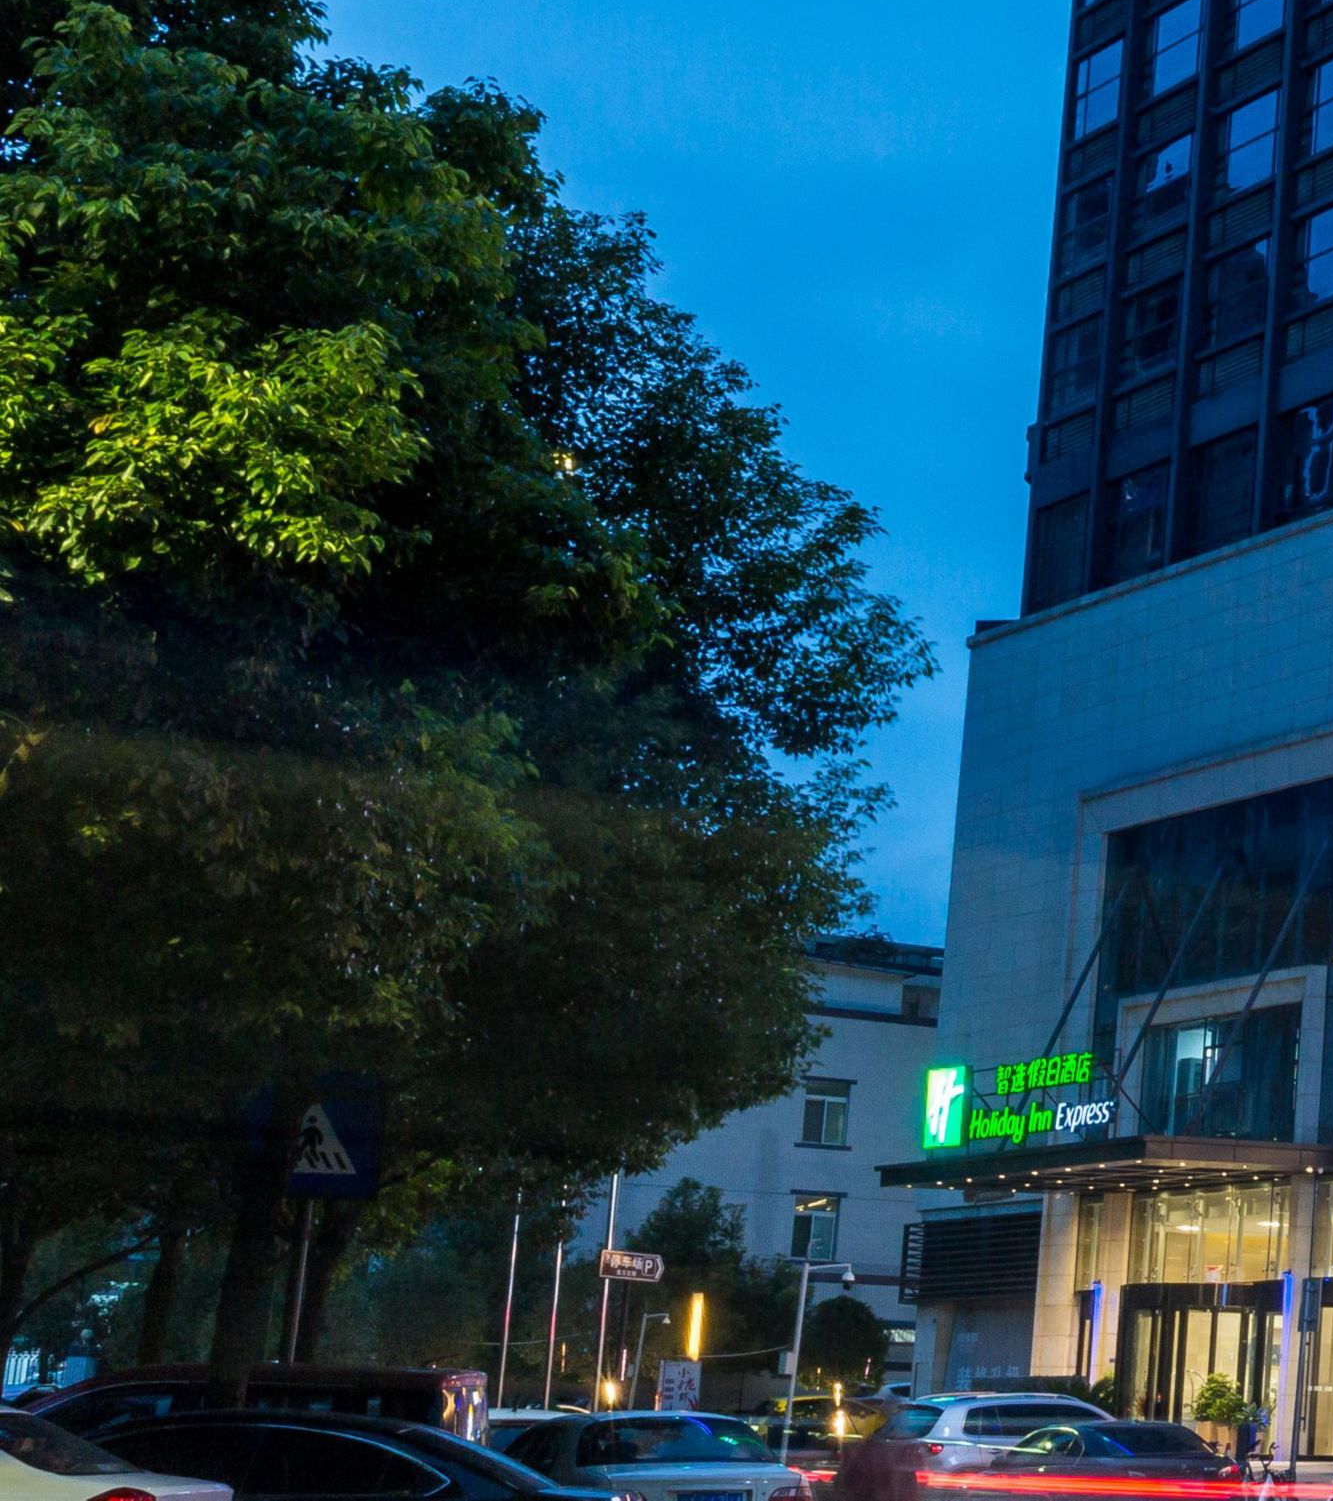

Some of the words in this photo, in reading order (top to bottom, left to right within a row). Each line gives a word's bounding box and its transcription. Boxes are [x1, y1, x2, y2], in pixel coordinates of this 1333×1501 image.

[996, 1052, 1095, 1095] 智选假日酒店
[969, 1107, 1026, 1144] Holiday
[1028, 1101, 1053, 1133] Inn
[1055, 1102, 1111, 1132] Express
